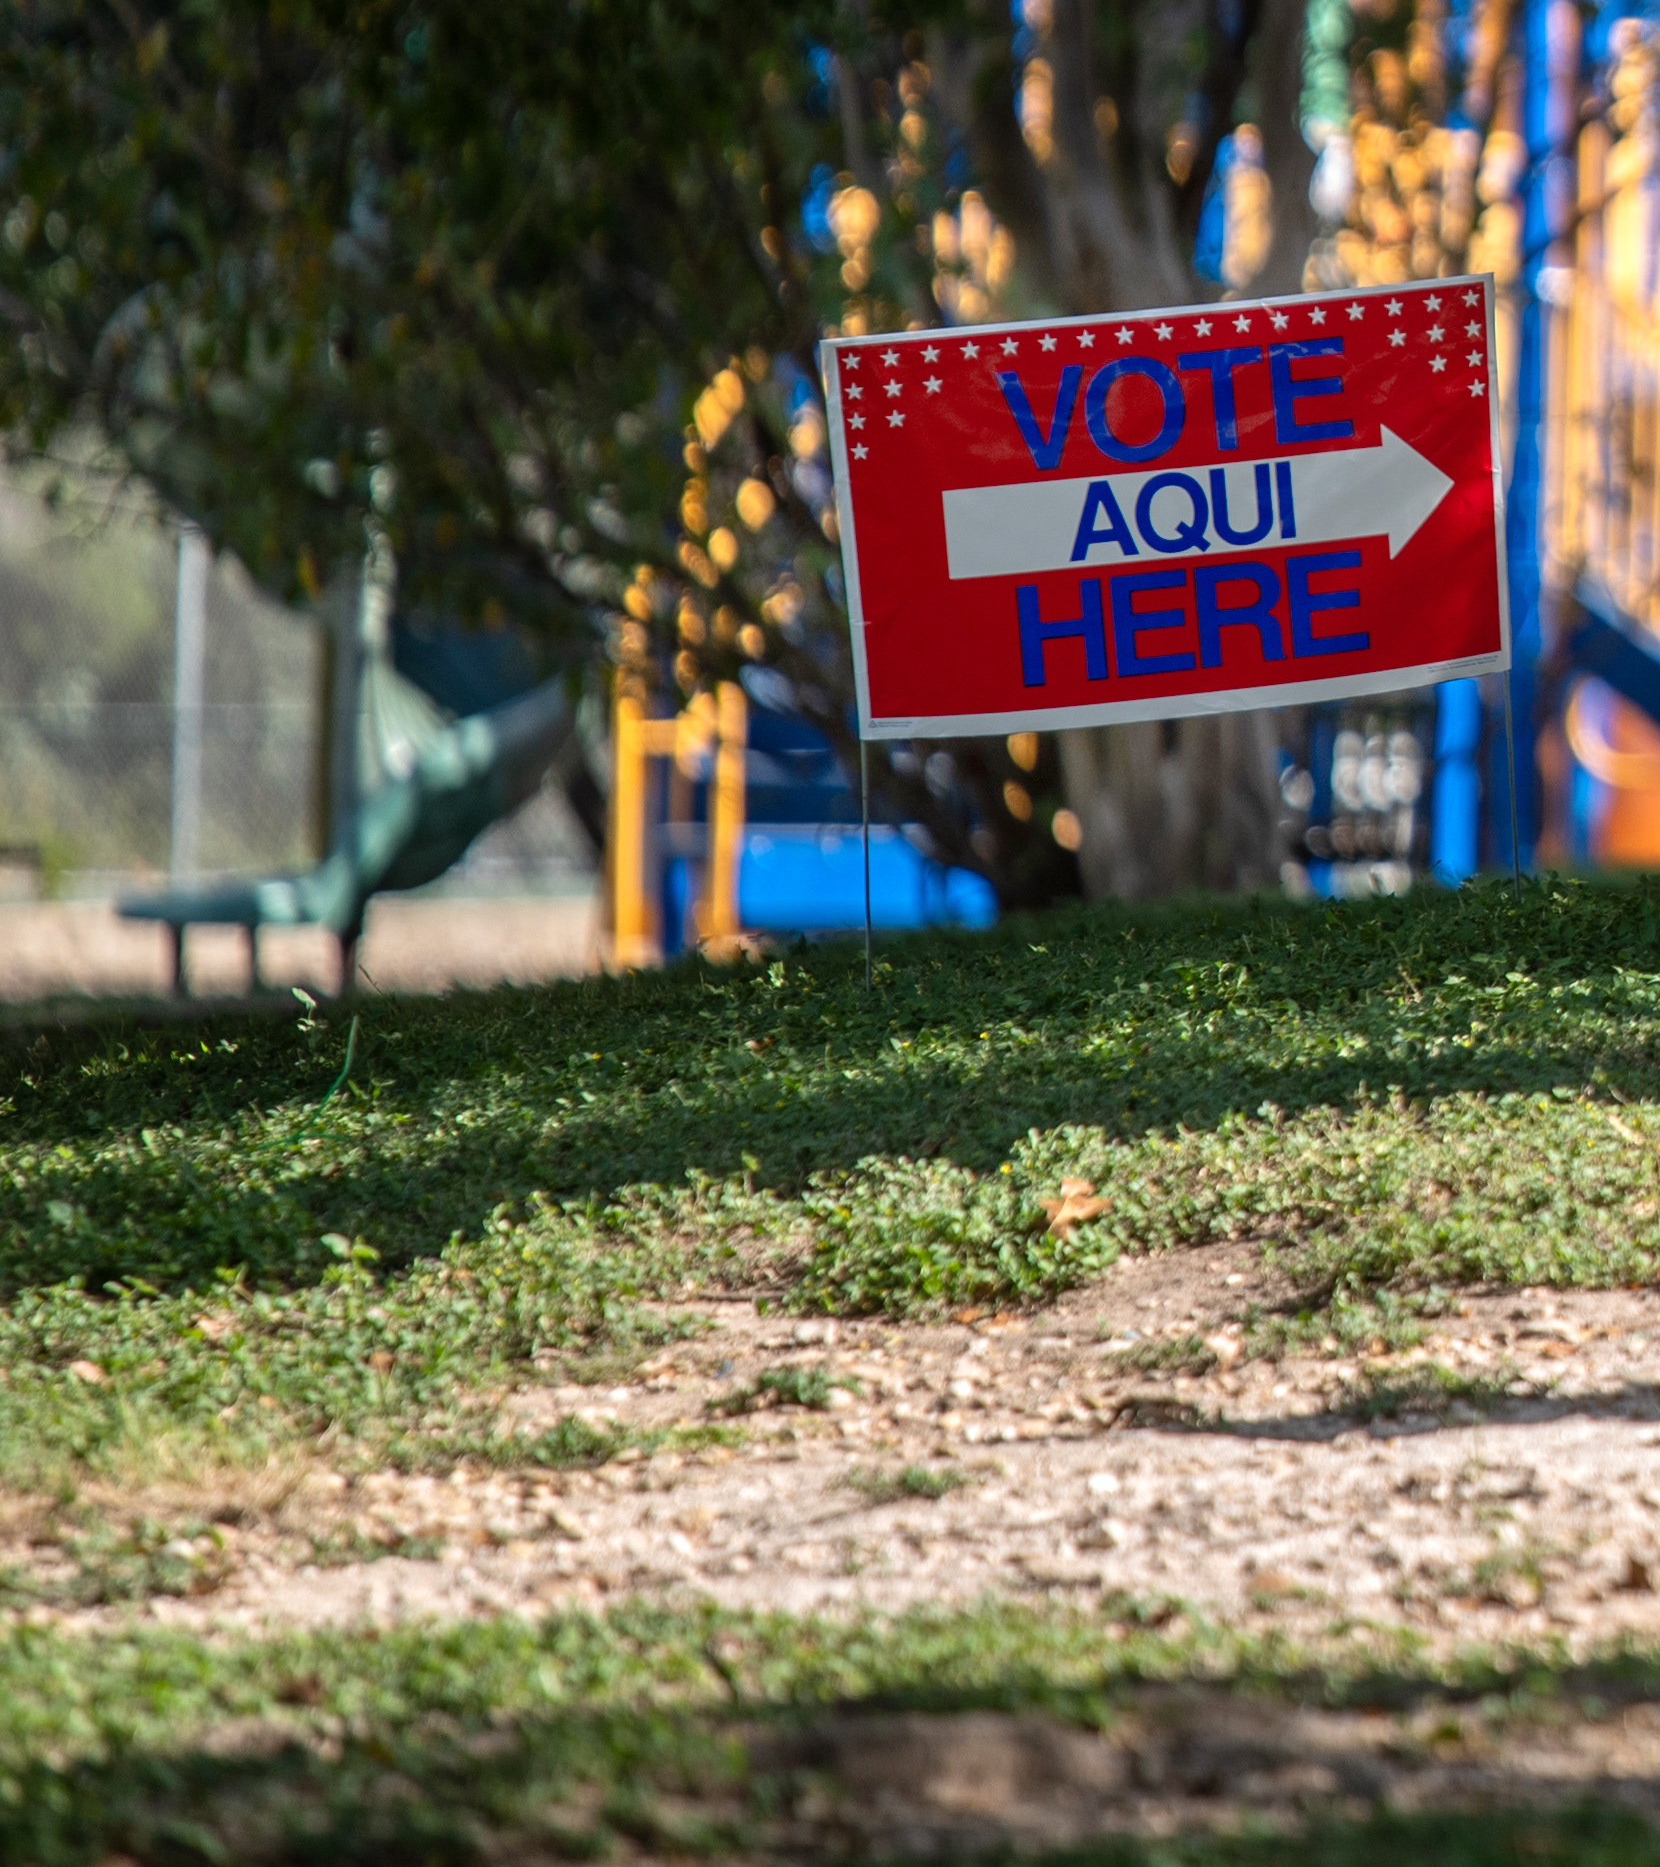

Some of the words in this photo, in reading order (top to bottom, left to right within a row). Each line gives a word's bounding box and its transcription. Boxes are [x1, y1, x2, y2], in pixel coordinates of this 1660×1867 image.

[996, 337, 1354, 471] VOTE
[1070, 461, 1297, 562] AQUI
[1015, 550, 1370, 687] HERE
